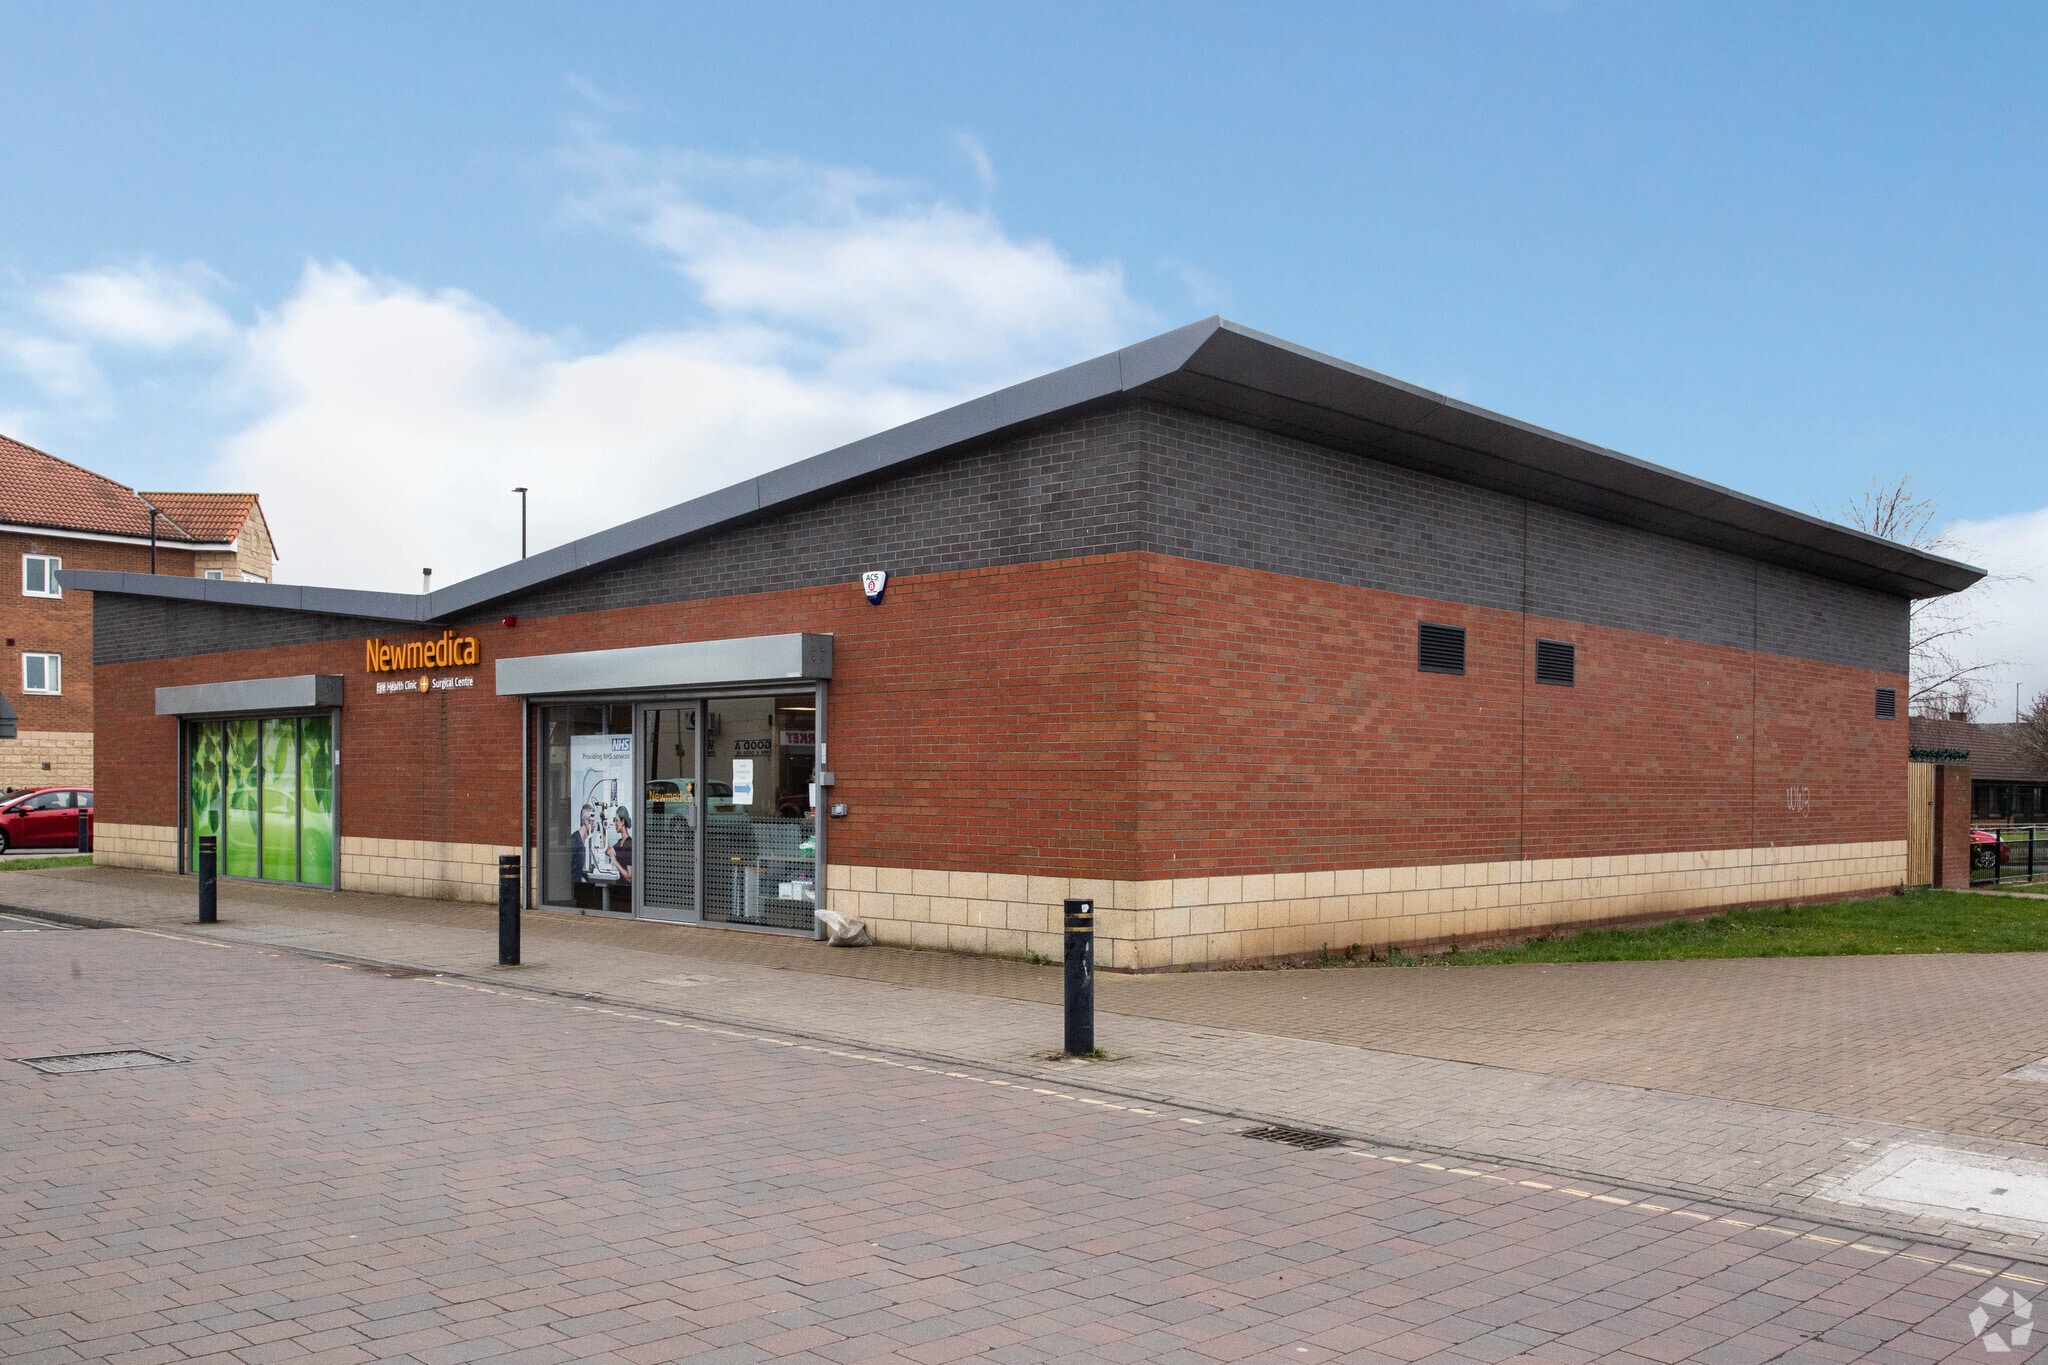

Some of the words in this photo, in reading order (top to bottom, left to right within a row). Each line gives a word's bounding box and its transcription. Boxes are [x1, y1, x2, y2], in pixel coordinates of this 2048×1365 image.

[866, 573, 879, 581] ACS
[366, 630, 480, 673] Newmedica
[376, 682, 387, 694] Eye
[387, 681, 404, 693] Health
[405, 680, 418, 690] Clinic
[432, 678, 454, 690] Surgical
[455, 676, 474, 687] Centre
[612, 739, 630, 750] NHS
[582, 752, 603, 761] Providing
[613, 752, 630, 760] services
[648, 790, 693, 803] Newmedica
